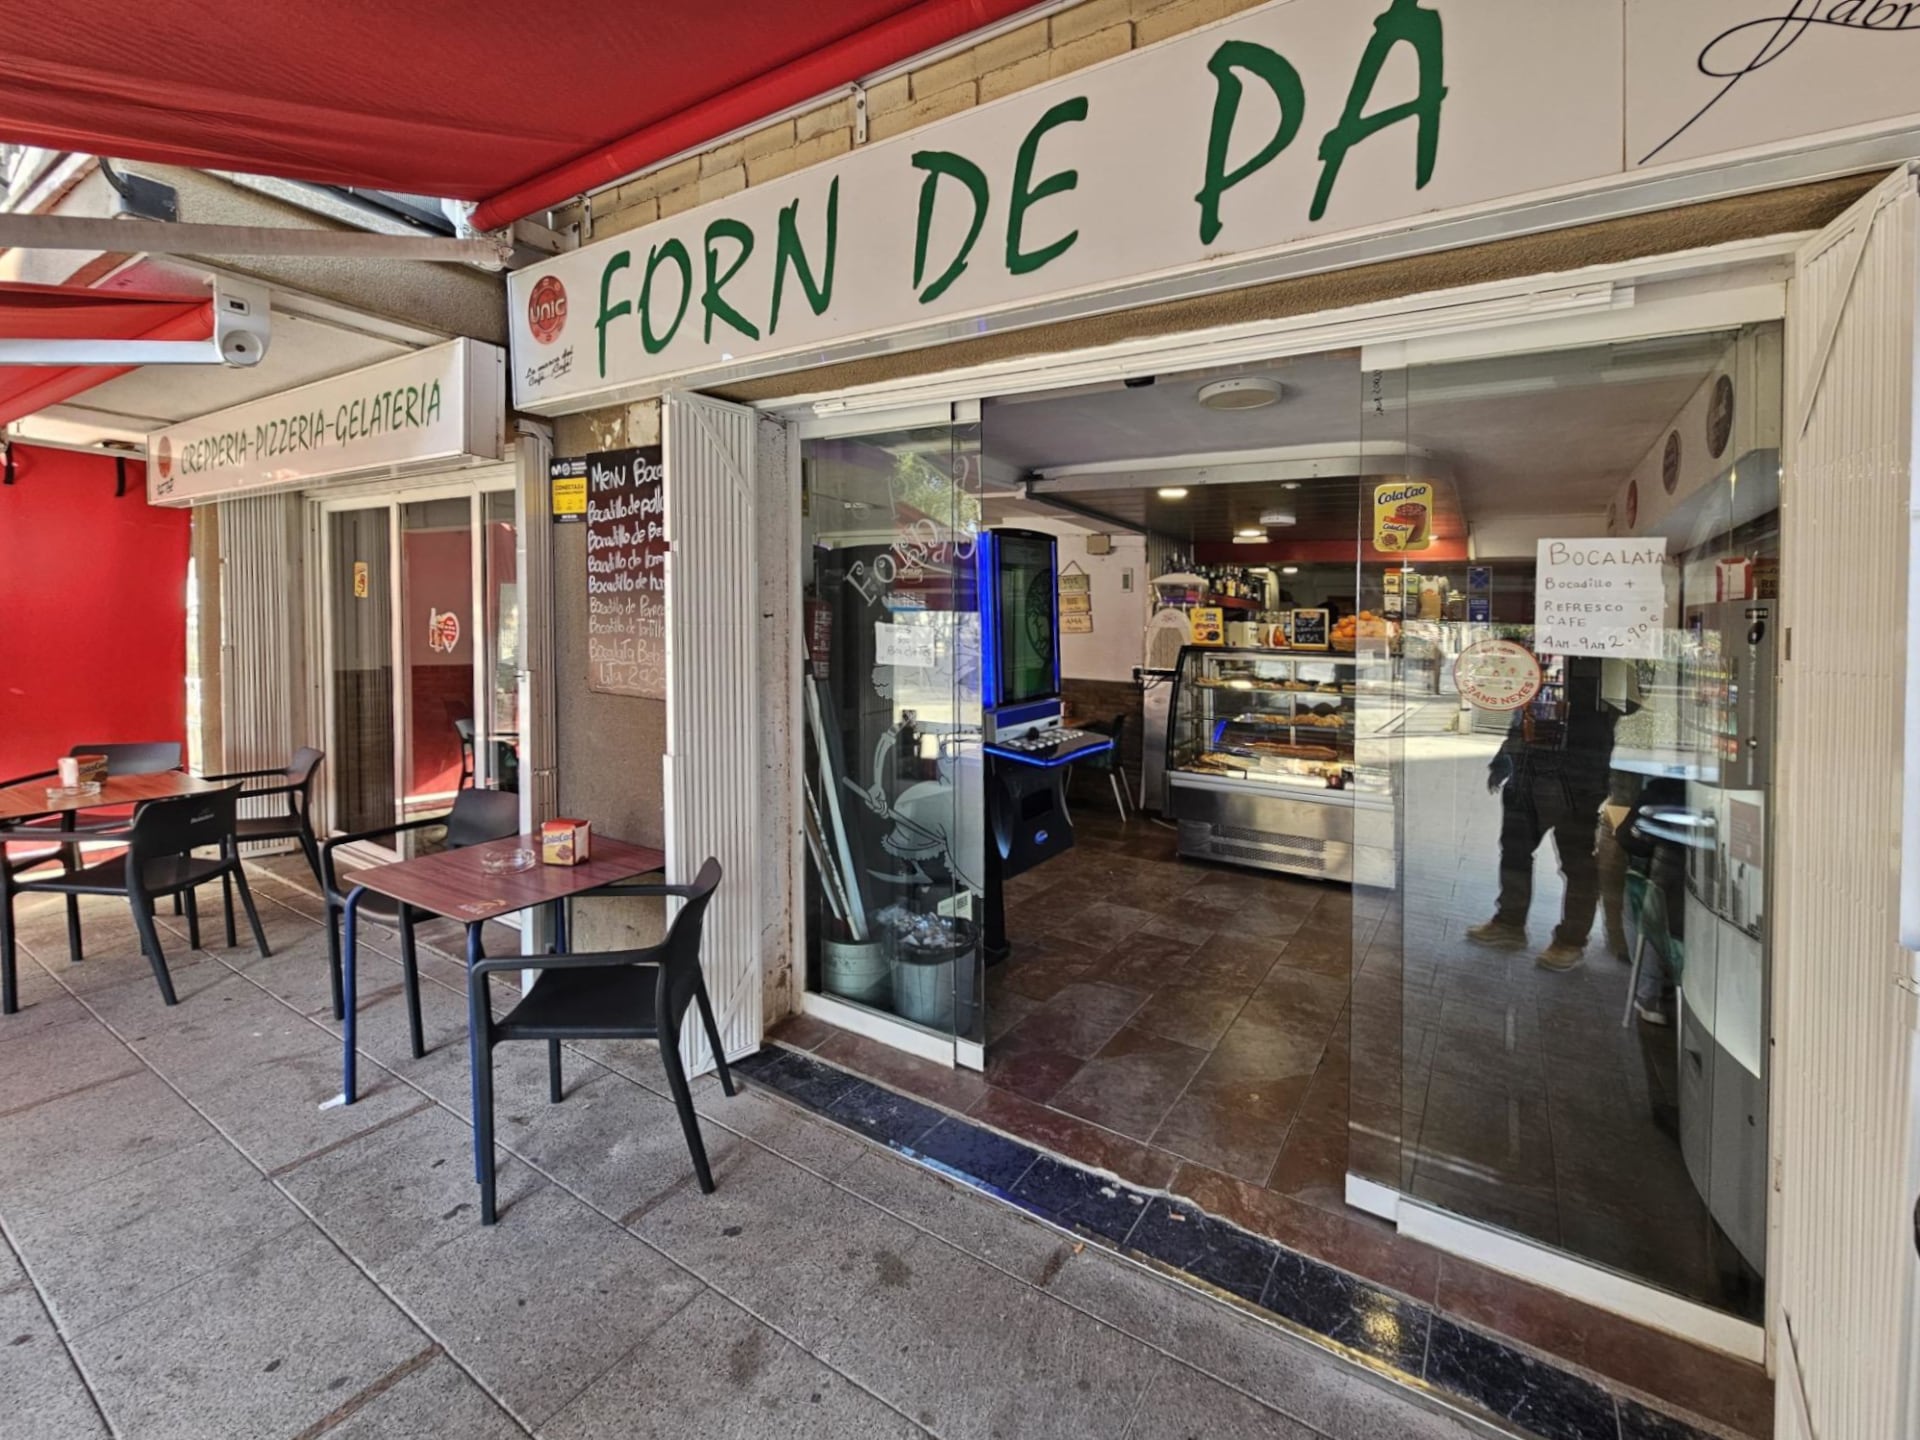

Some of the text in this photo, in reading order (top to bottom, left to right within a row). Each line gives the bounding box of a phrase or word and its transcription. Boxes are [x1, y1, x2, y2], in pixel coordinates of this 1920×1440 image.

[594, 175, 838, 378] FORN
[911, 97, 1089, 304] DE
[1378, 486, 1426, 505] ColaCao
[1549, 541, 1667, 567] BOCALATA
[1544, 600, 1624, 613] REFRESCO
[1545, 615, 1587, 628] CAFE
